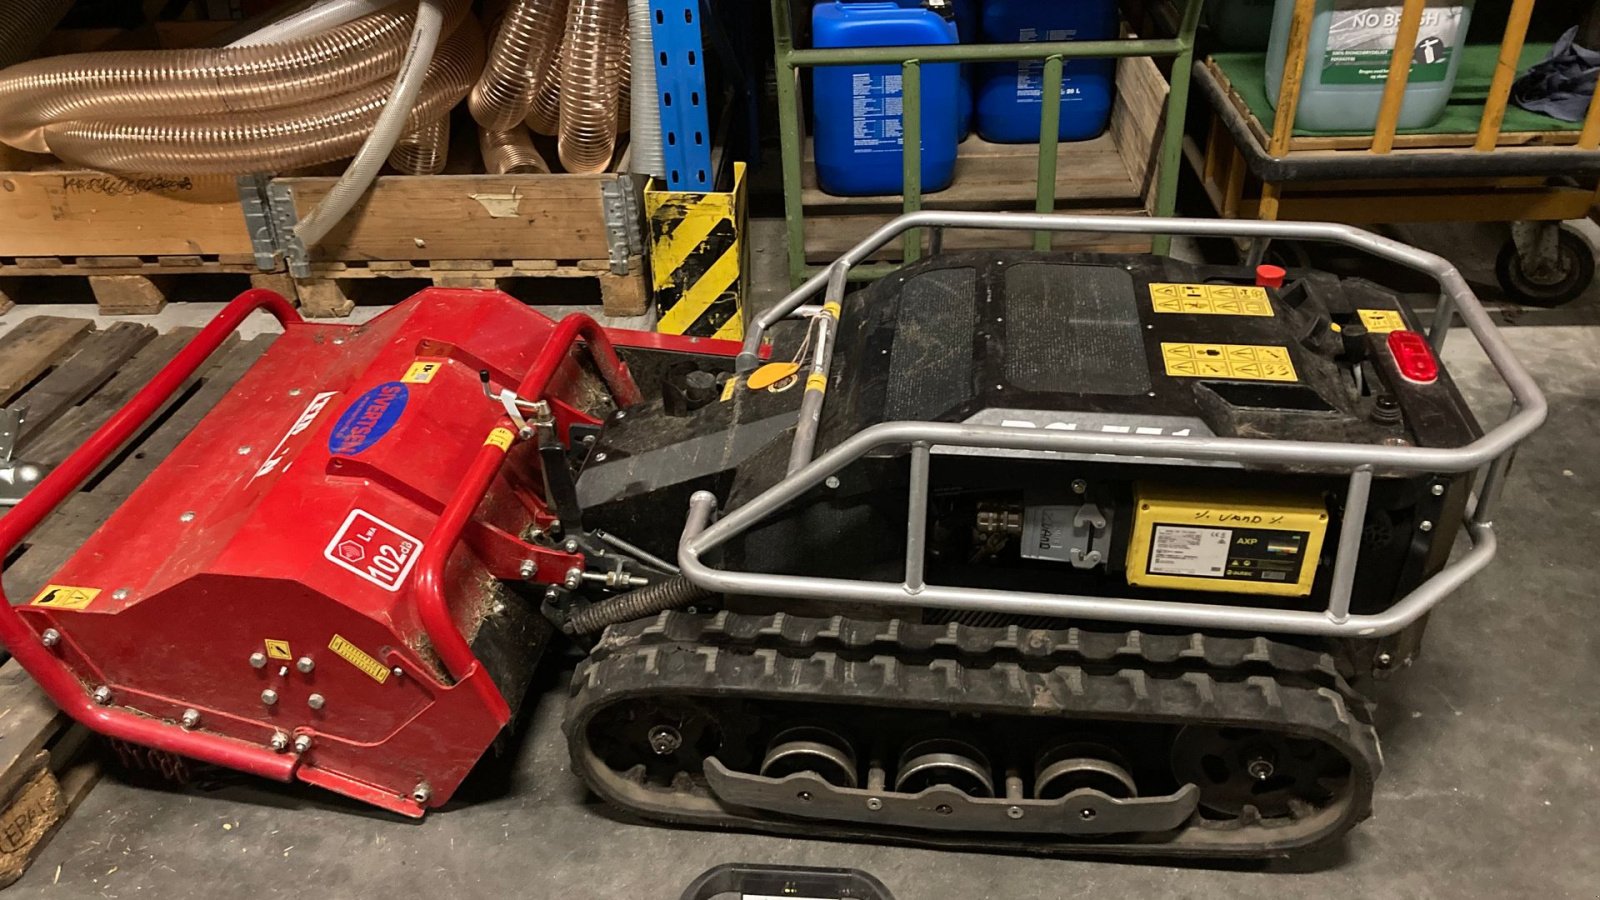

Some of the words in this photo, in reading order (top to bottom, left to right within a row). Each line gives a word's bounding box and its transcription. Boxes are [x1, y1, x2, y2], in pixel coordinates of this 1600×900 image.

[1353, 13, 1380, 28] NO
[338, 385, 401, 453] SIVERTSEN
[1236, 537, 1258, 545] AXP
[367, 544, 406, 582] 102
